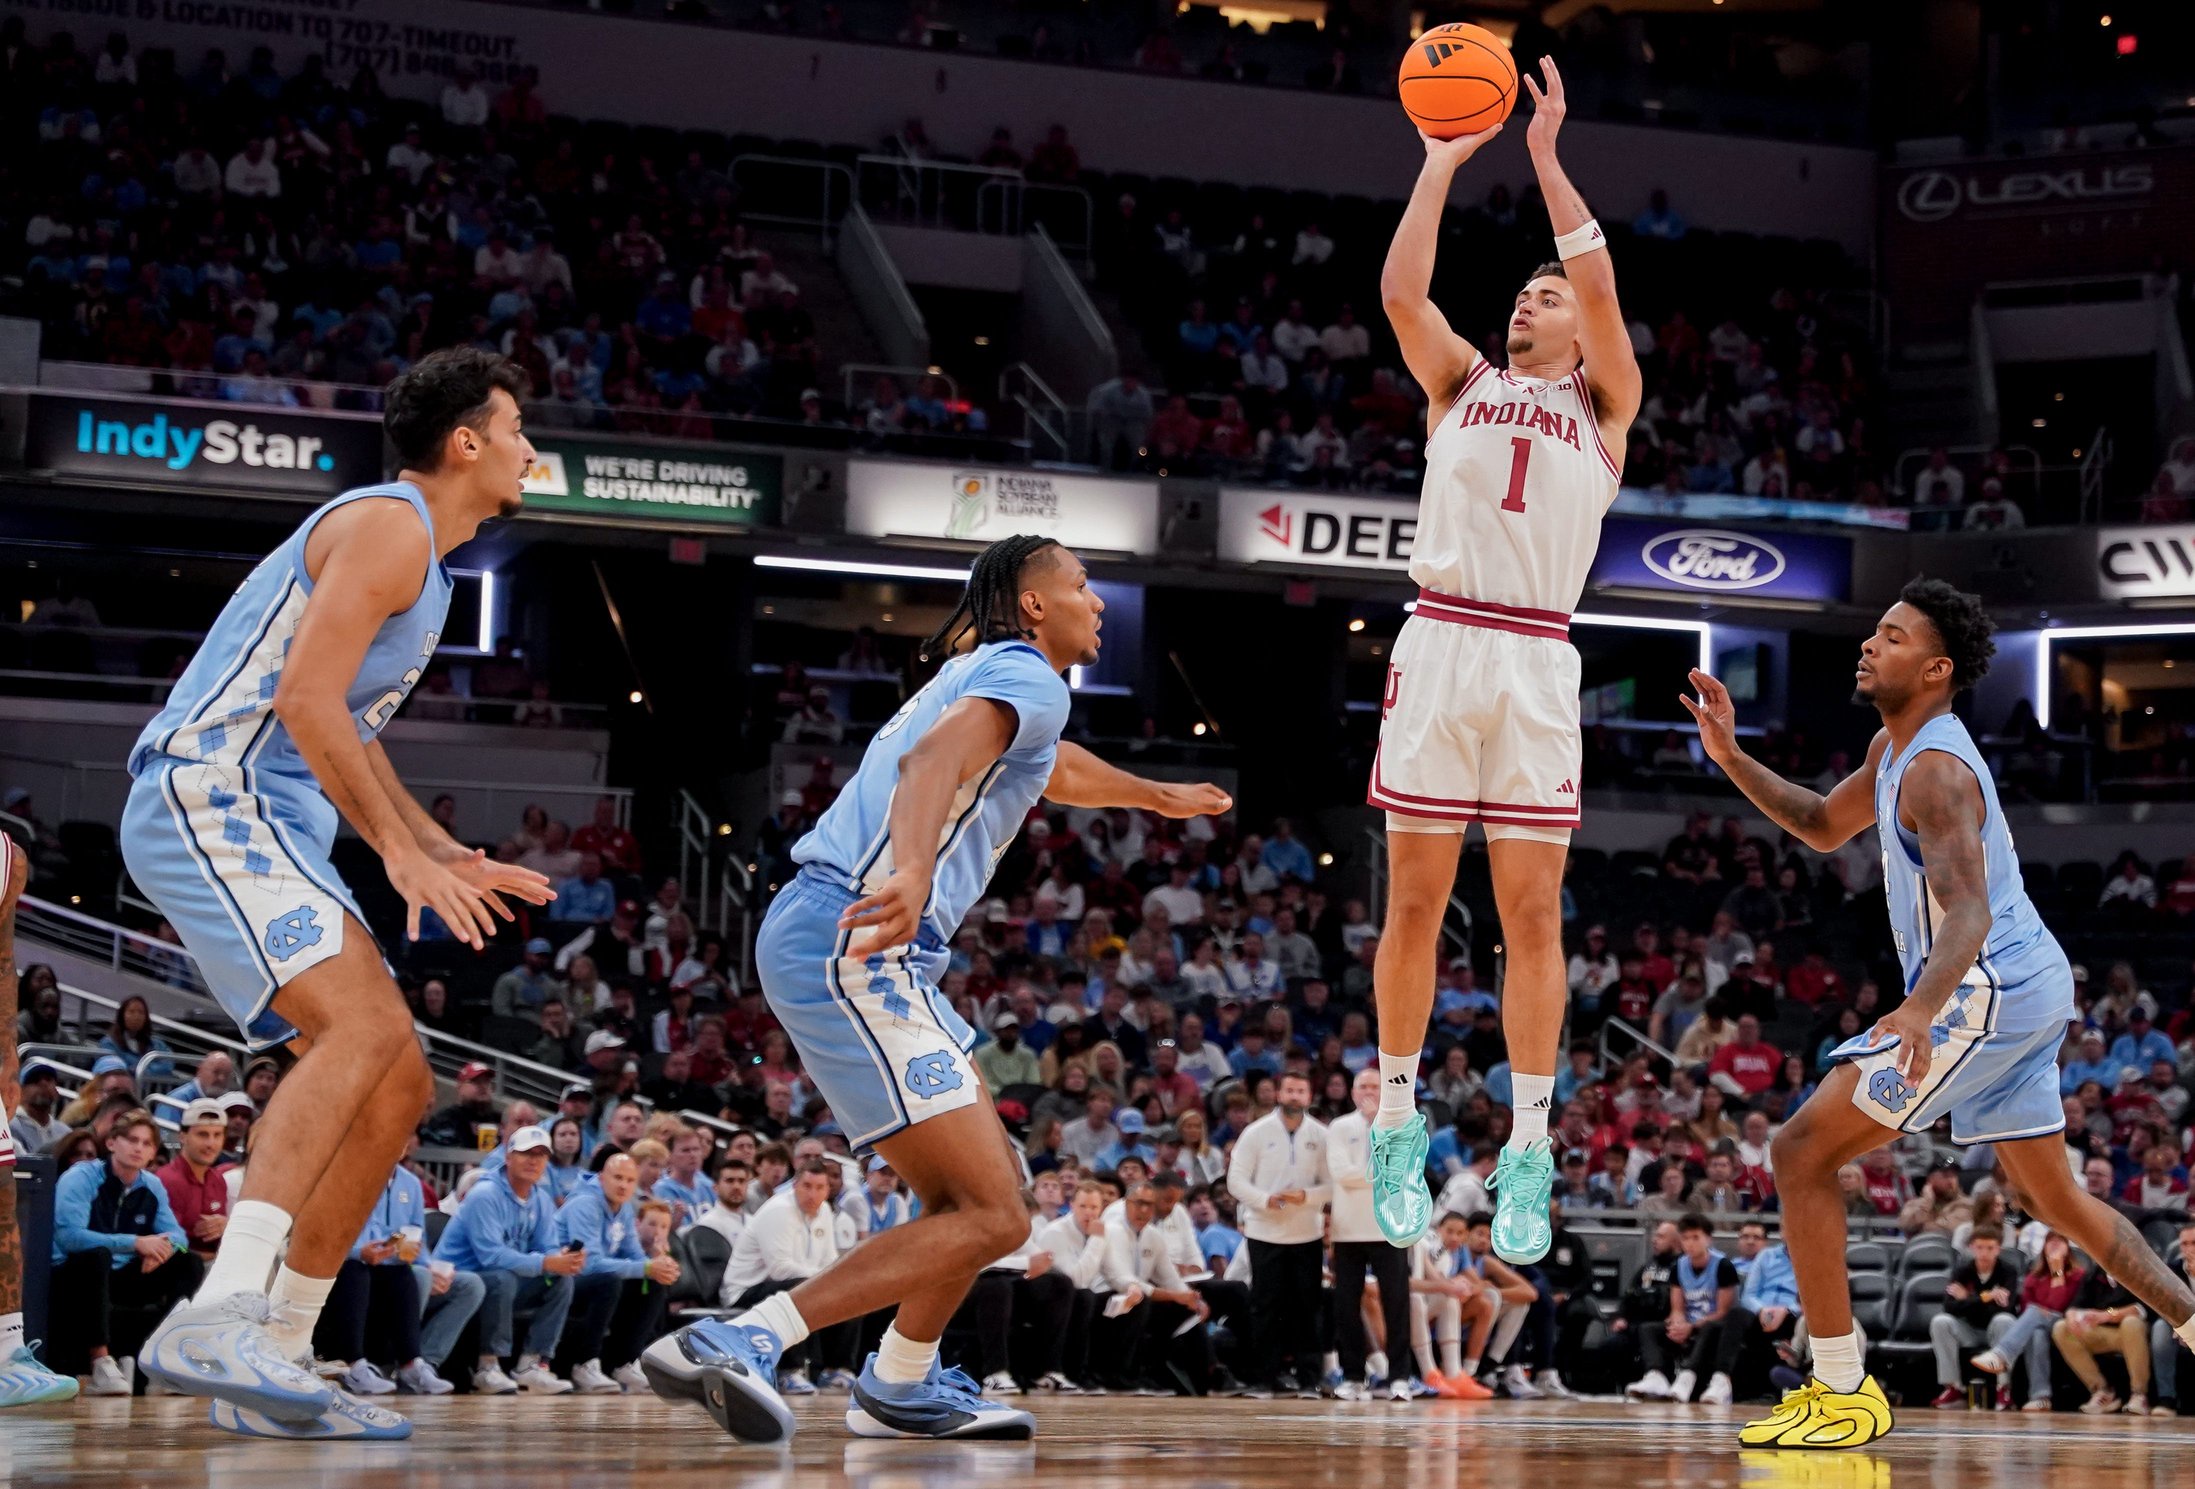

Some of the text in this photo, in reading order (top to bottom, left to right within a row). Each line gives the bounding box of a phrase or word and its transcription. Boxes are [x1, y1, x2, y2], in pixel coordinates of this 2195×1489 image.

[163, 1, 293, 34] LOCATION
[302, 15, 332, 39] TO
[1968, 165, 2154, 204] LEXUS
[1459, 401, 1582, 452] INDIANA
[585, 454, 655, 481] WE'RE
[658, 460, 748, 488] DRIVING
[1500, 436, 1532, 513] 1
[1668, 537, 1760, 581] Ford
